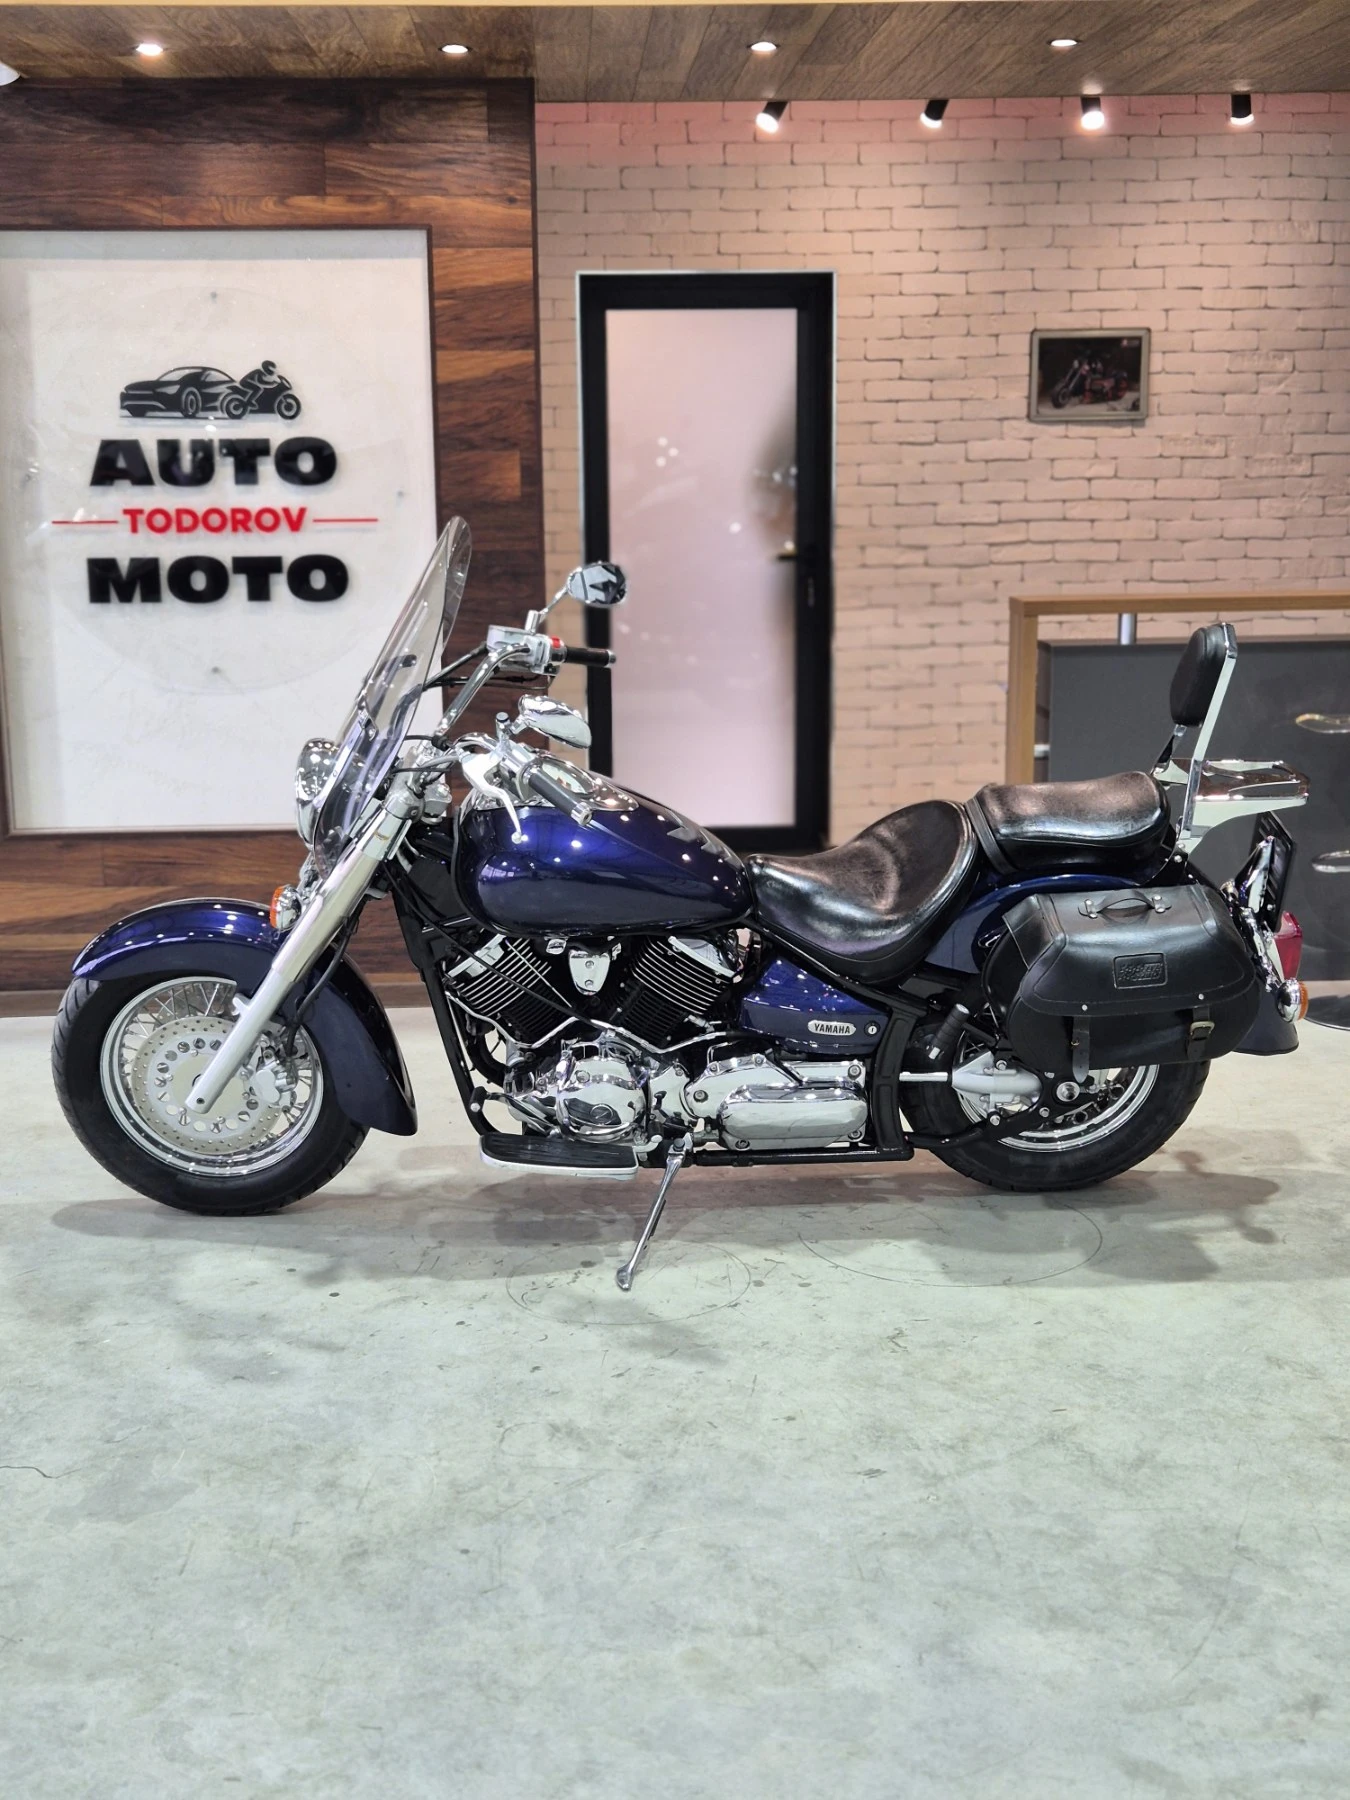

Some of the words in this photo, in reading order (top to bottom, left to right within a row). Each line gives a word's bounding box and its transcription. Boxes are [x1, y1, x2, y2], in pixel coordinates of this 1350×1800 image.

[90, 436, 337, 486] AUTO
[122, 507, 307, 533] TODOROV
[87, 554, 349, 603] MOTO
[814, 1023, 851, 1034] YAMAHA
